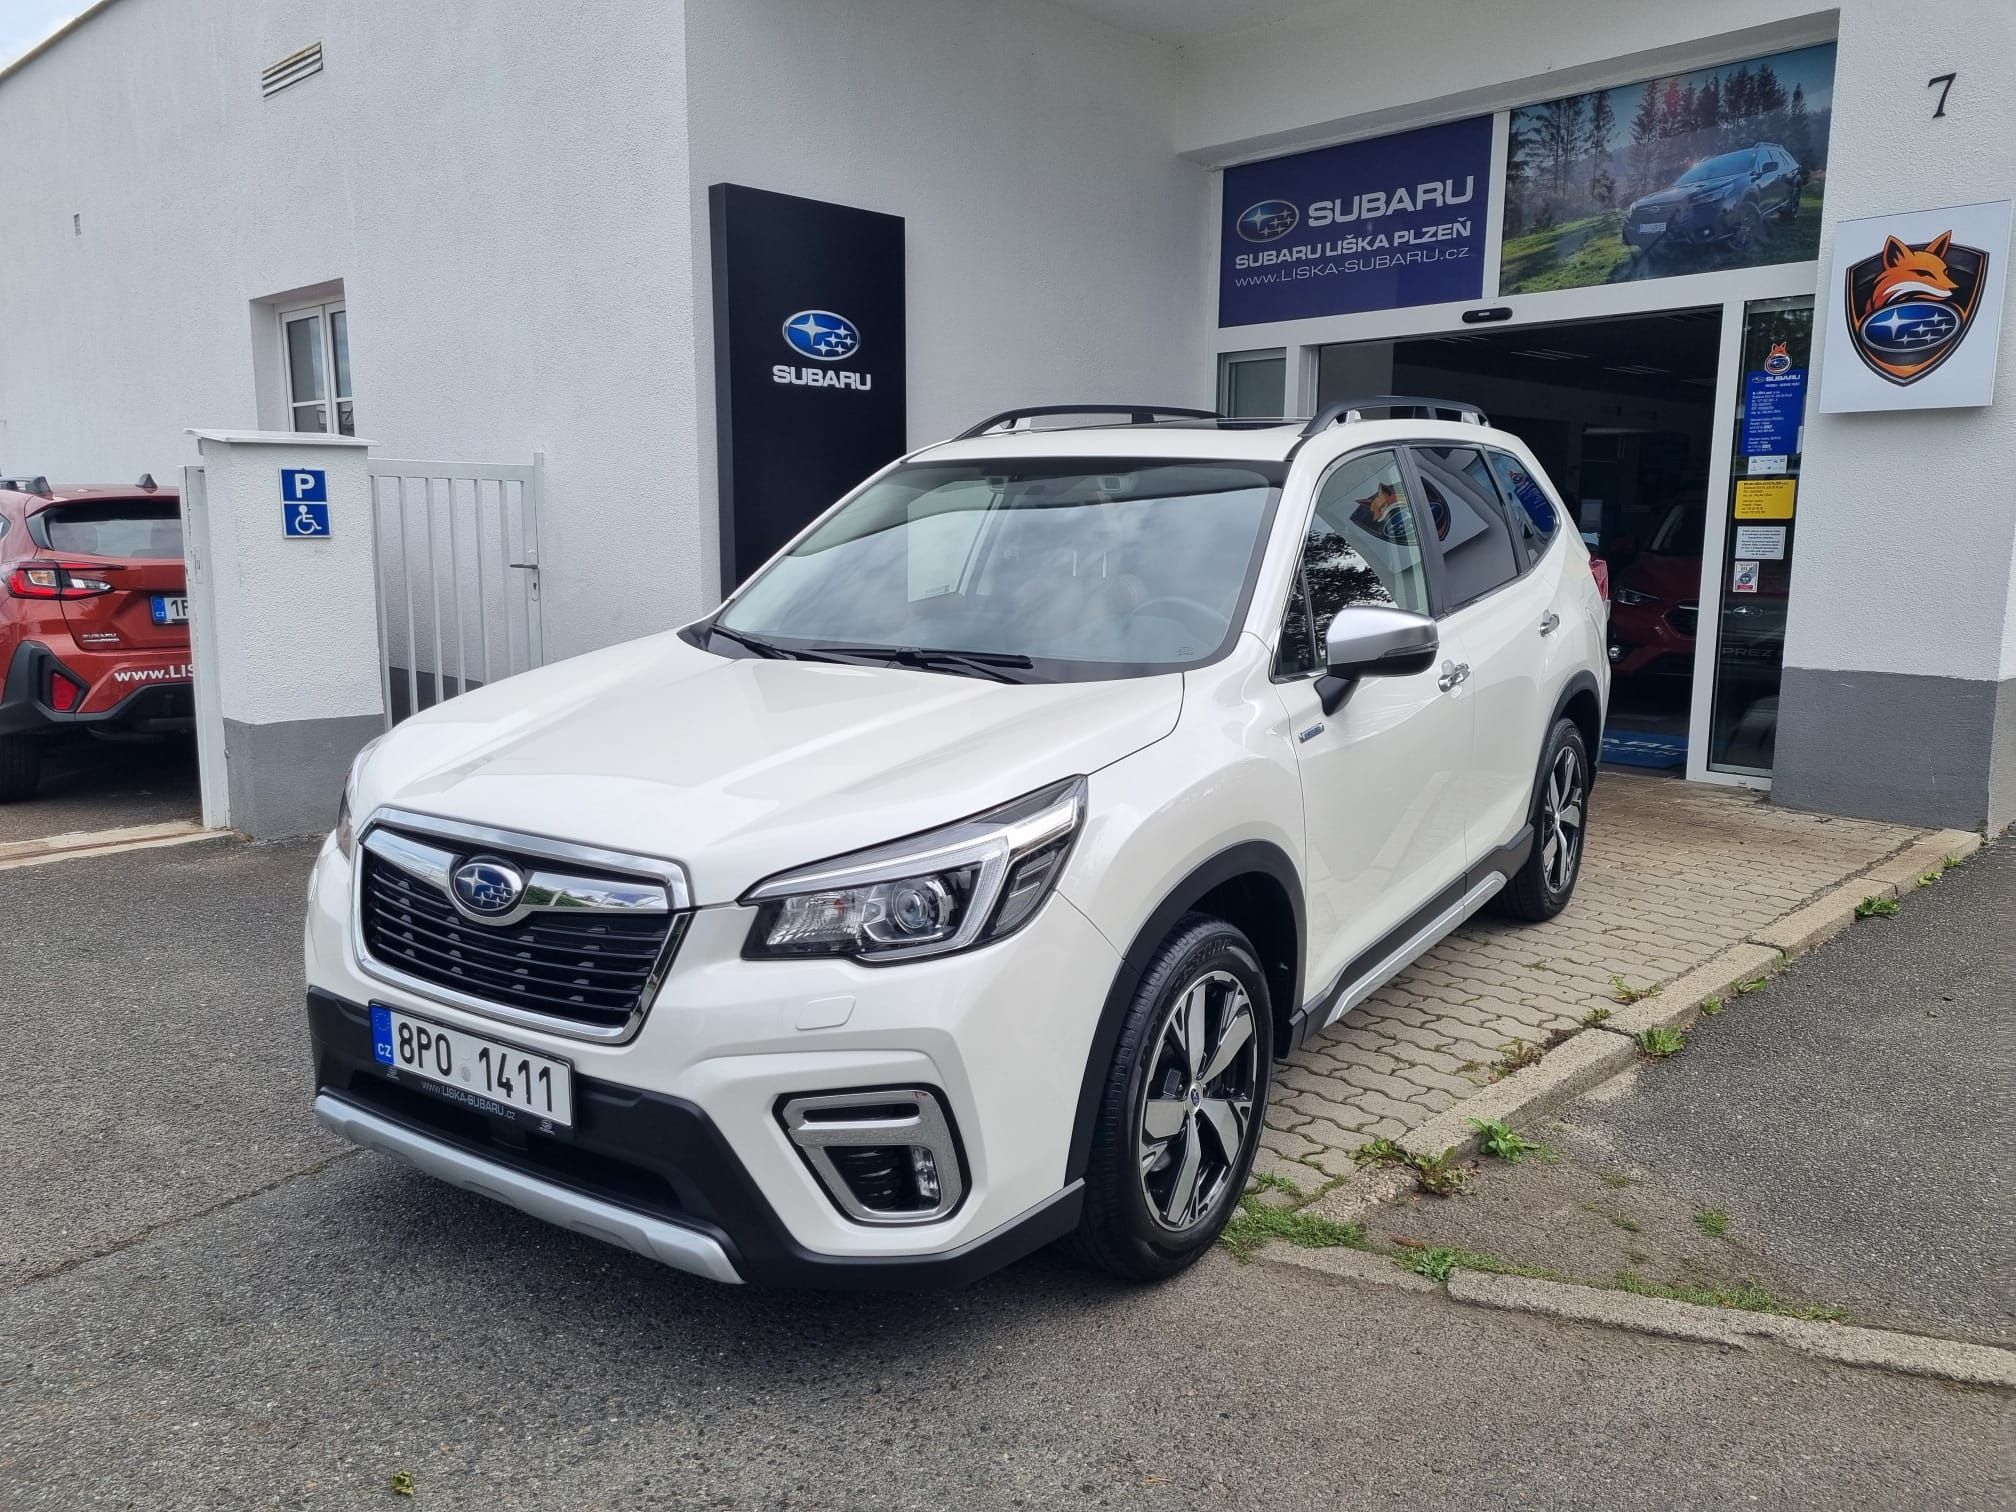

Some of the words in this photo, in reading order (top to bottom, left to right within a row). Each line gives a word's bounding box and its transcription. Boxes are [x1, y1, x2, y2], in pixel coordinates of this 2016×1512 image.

[1927, 72, 1957, 119] 7
[1308, 175, 1475, 228] SUBARU
[1235, 243, 1322, 270] SUBARU
[1326, 234, 1389, 258] LIŠKA
[1393, 217, 1471, 247] PLZEŇ
[1235, 247, 1470, 287] www.LISKA-SUBARU.cz
[772, 365, 872, 391] SUBARU
[295, 473, 315, 499] P
[377, 1042, 392, 1058] CZ
[398, 1021, 453, 1077] 8P0
[478, 1046, 553, 1112] 1411
